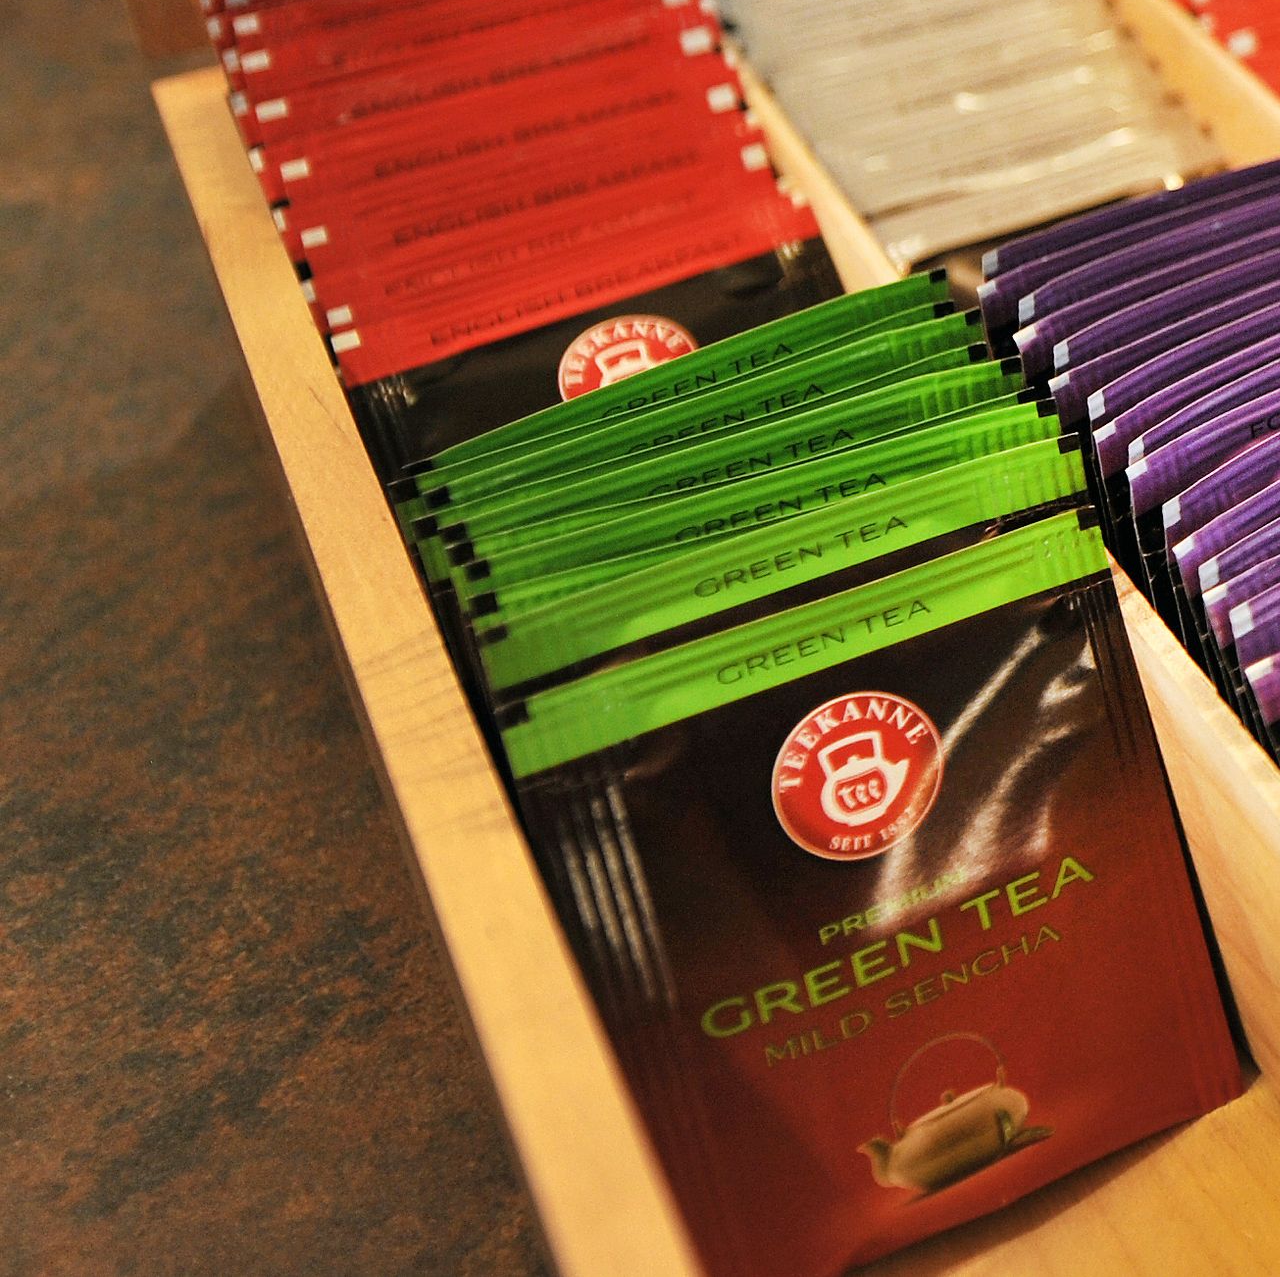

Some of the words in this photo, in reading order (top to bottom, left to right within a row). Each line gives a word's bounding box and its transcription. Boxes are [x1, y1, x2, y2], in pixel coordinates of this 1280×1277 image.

[728, 343, 793, 375] TEA
[757, 383, 825, 414] TEA
[784, 428, 854, 459] TEA
[815, 472, 887, 503] TEA
[693, 542, 823, 598] GREEN
[833, 515, 908, 549] TEA
[716, 625, 845, 685] GREEN
[856, 600, 931, 634] TEA
[778, 698, 930, 794] TEEKANNE
[818, 868, 969, 945] PREMIUM
[700, 918, 944, 1039] GREEN
[959, 856, 1096, 932] TEA
[764, 1009, 872, 1068] MILD
[883, 923, 1064, 1021] SENCHA
